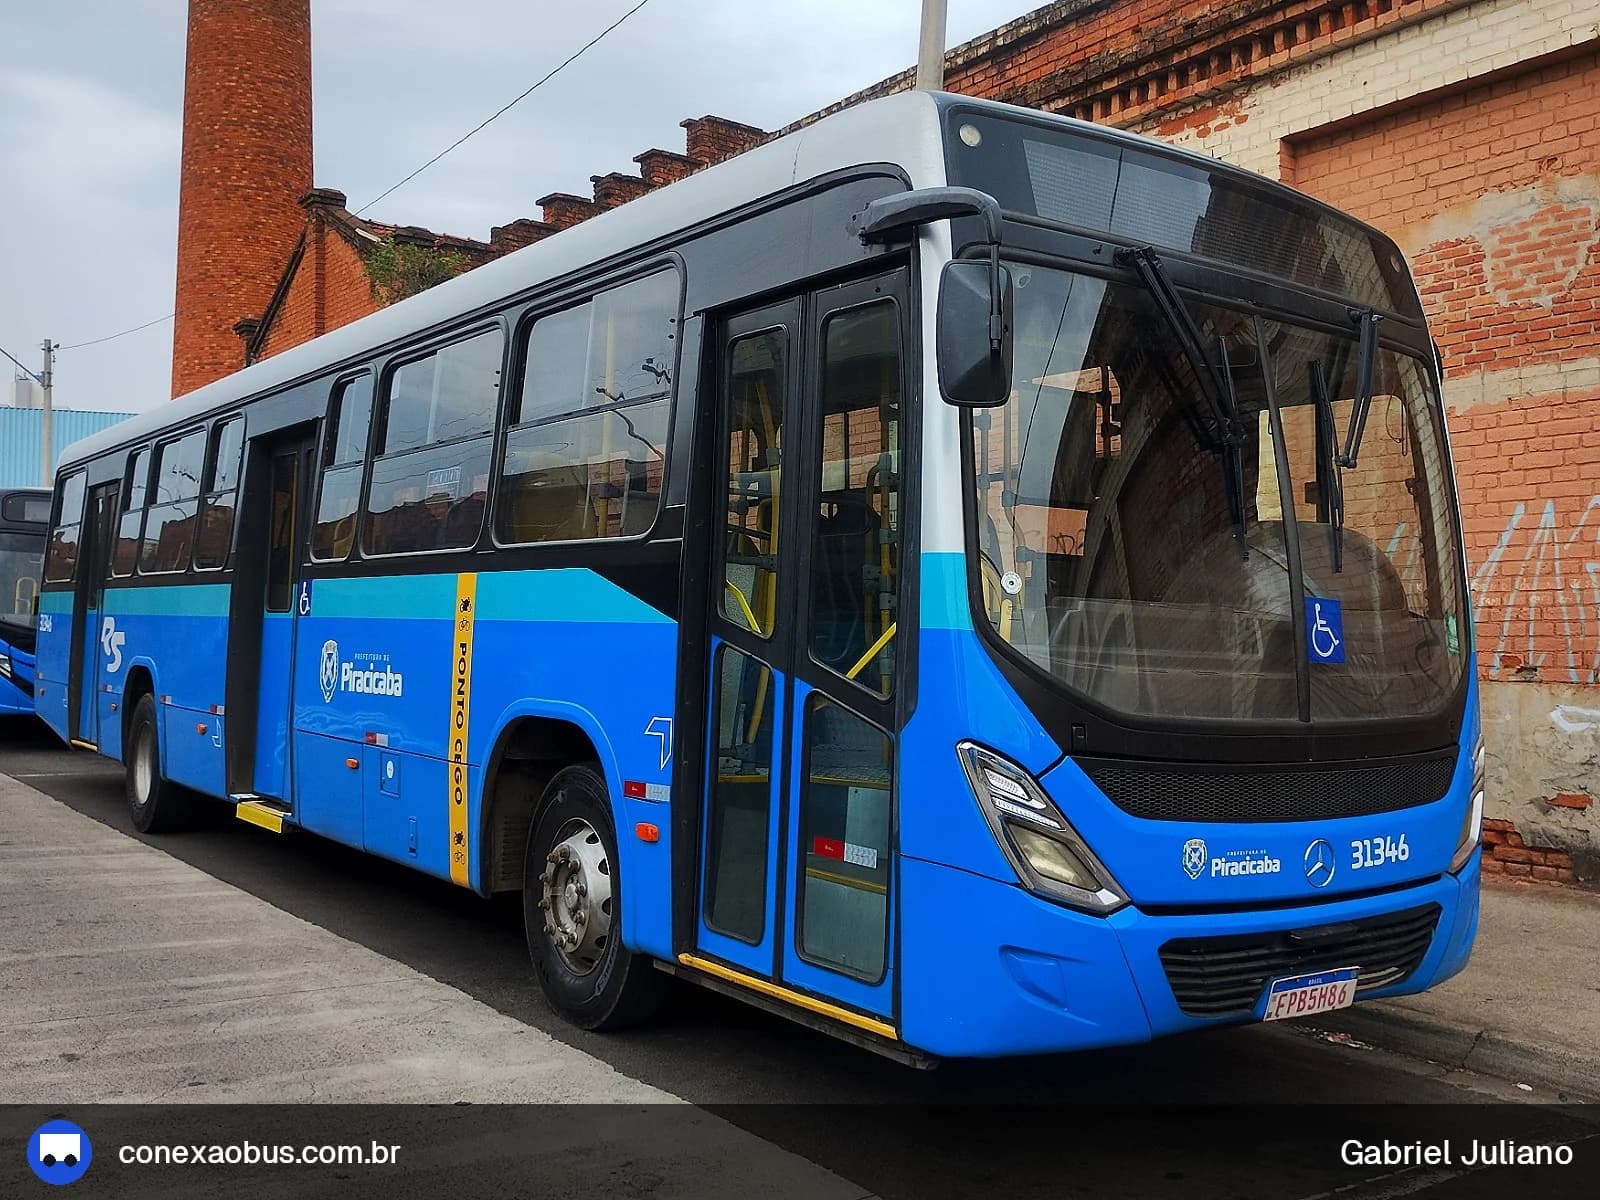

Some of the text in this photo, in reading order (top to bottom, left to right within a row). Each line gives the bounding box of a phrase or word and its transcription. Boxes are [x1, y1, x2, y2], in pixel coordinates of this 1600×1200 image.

[341, 662, 402, 697] Piracicaba
[454, 643, 467, 805] PONTO CEGO
[1211, 856, 1281, 877] Piracicaba
[1351, 834, 1409, 869] 31346
[1275, 984, 1347, 1017] FPB5H86
